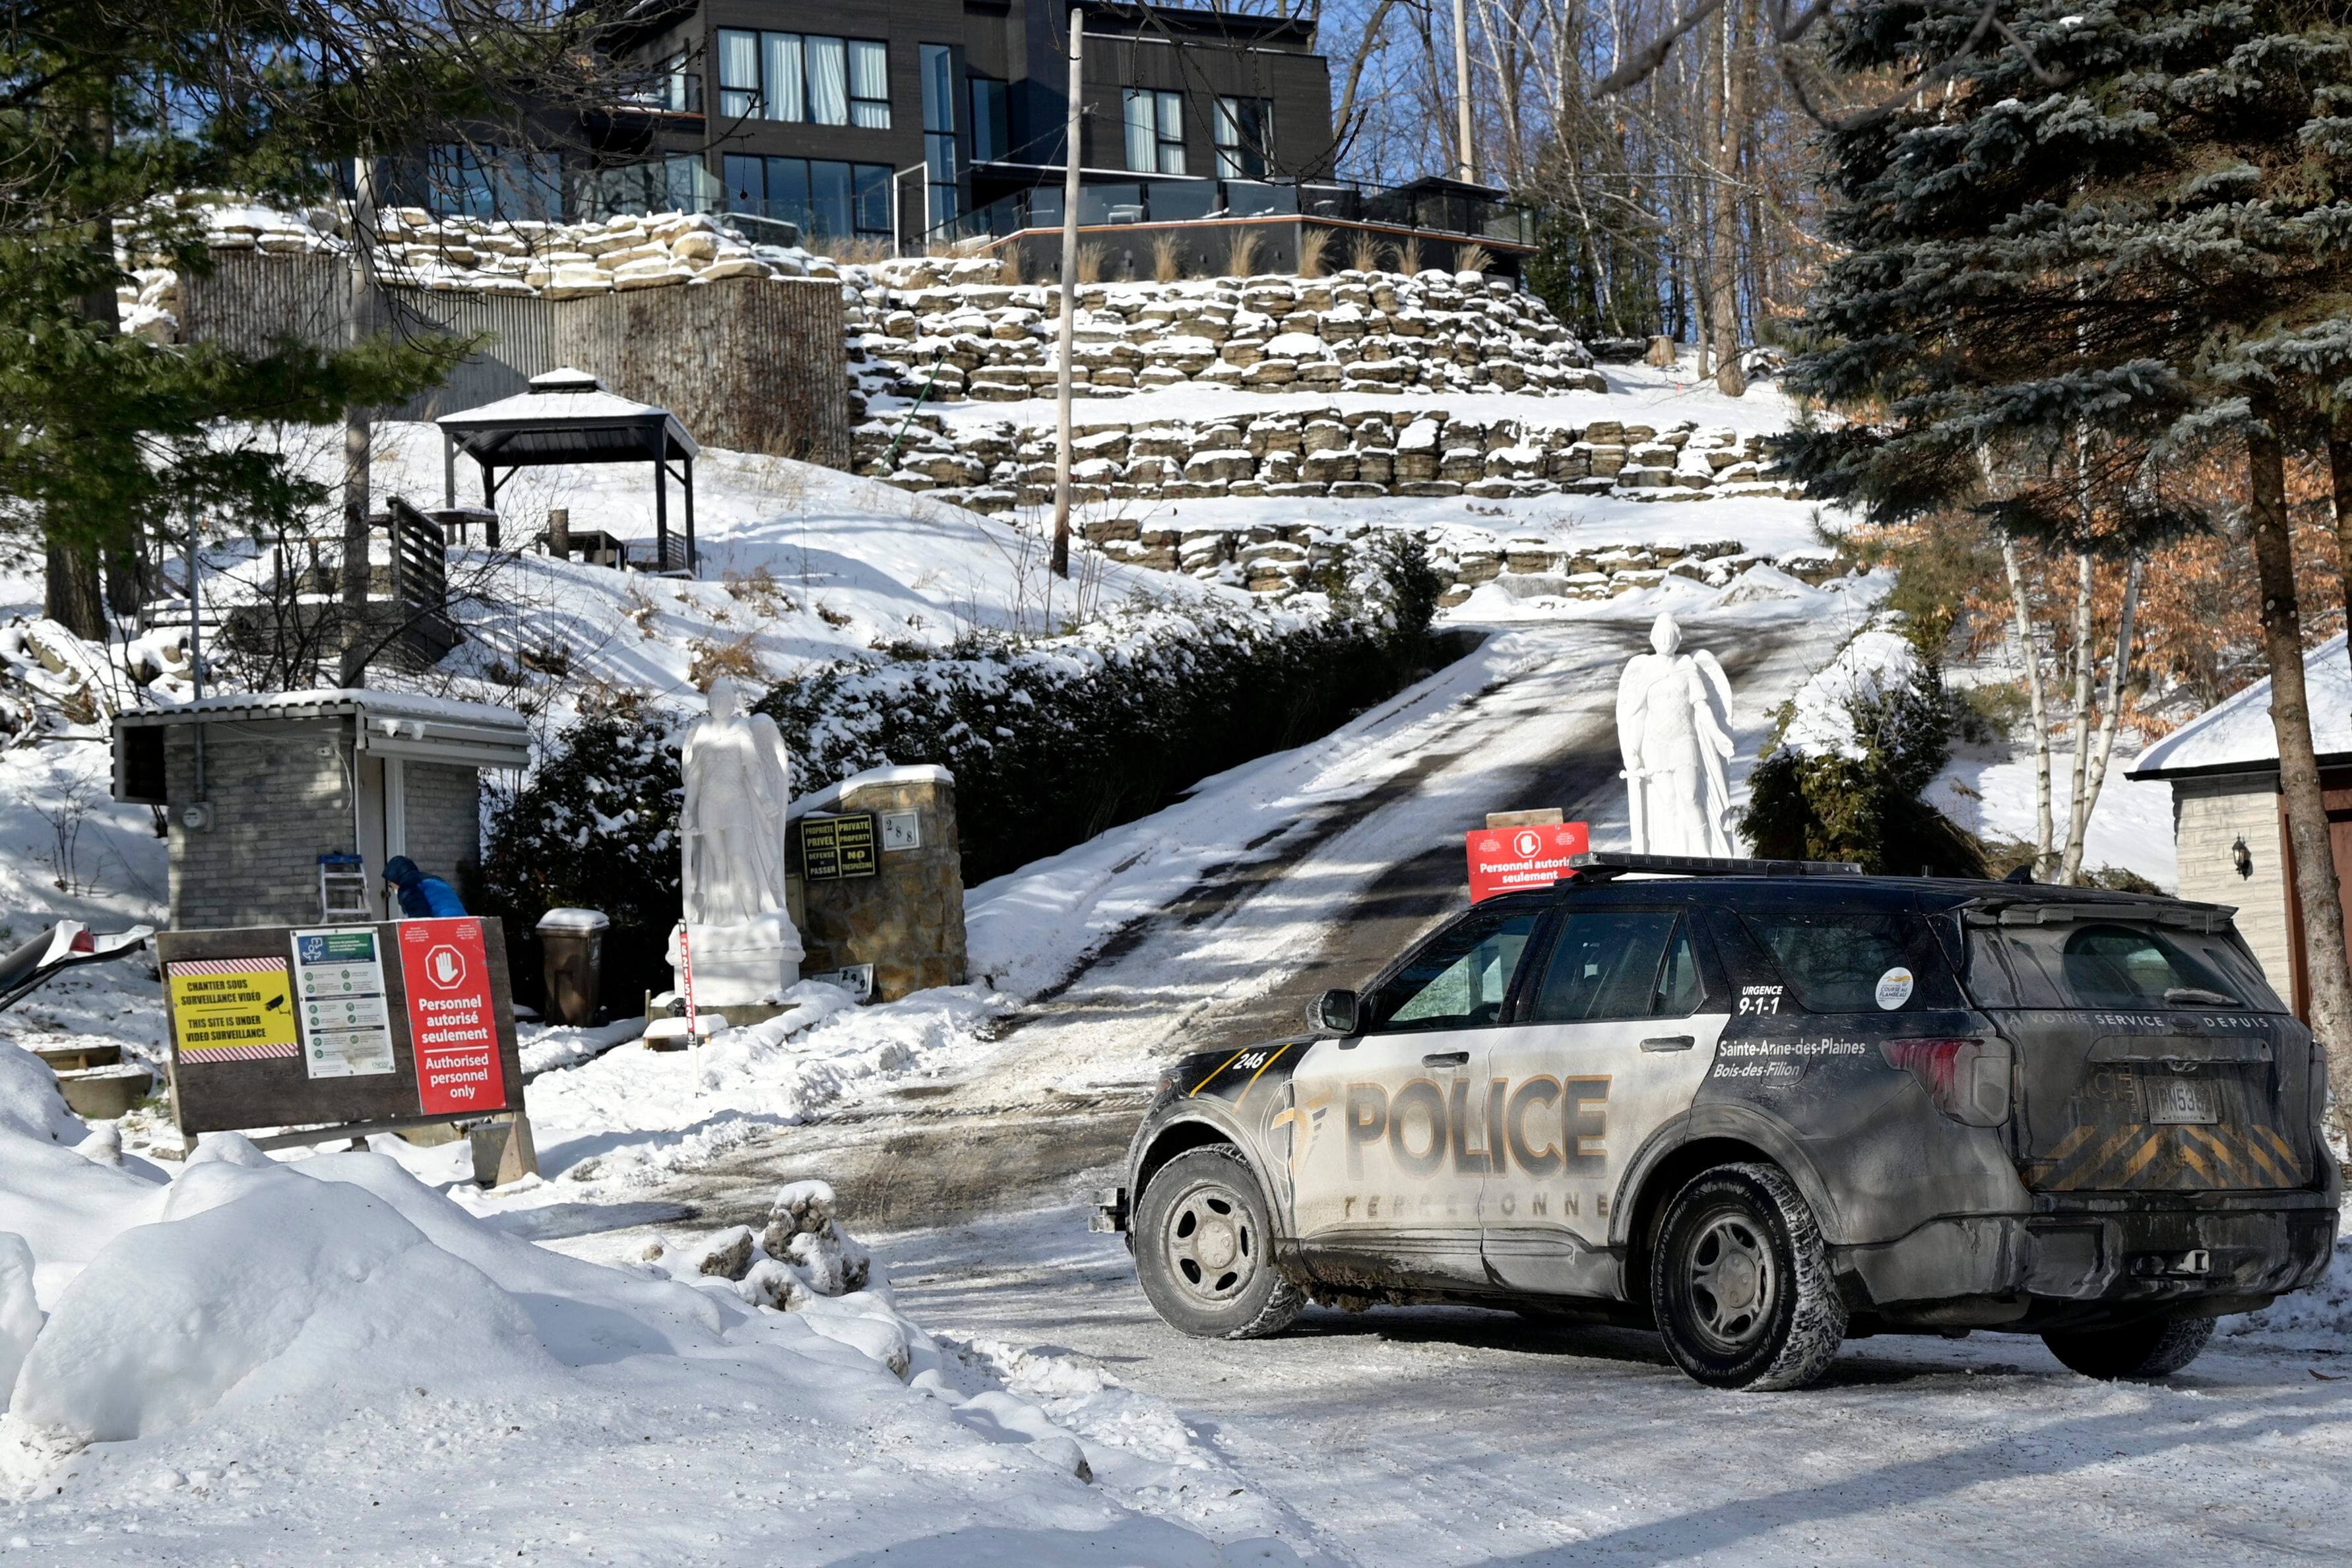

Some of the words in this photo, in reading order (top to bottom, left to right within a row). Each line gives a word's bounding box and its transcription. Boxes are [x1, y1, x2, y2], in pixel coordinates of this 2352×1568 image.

[839, 822, 870, 832] PRIVATE
[886, 819, 912, 843] 288
[839, 833, 870, 842] PROPERTY
[847, 850, 865, 860] NO
[810, 865, 836, 875] PASSER
[842, 862, 872, 871] TRESPASSING
[1480, 860, 1533, 873] Personnel
[1535, 856, 1570, 868] autoris
[1502, 870, 1558, 884] seulement
[187, 980, 225, 991] CHANTIER
[226, 980, 247, 989] SOUS
[1742, 986, 1783, 996] URGENCE
[181, 993, 237, 1005] SURVEILLANCE
[418, 994, 482, 1011] Personnel
[1739, 996, 1780, 1015] 9-1-1
[187, 1019, 207, 1028] THIS
[208, 1017, 225, 1028] SITE
[226, 1017, 234, 1026] IS
[236, 1015, 261, 1026] UNDER
[427, 1011, 479, 1027] autorisé
[2028, 1013, 2090, 1024] VOTRE
[2095, 1014, 2165, 1026] SERVICE
[2204, 1017, 2269, 1028] DEPUIS
[185, 1032, 209, 1042] VIDEO
[211, 1028, 266, 1041] SURVEILLANCE
[422, 1028, 488, 1044] seulement
[1720, 1038, 1866, 1057] Sainte-Anne-des-Plaines
[426, 1053, 489, 1070] Authorised
[1232, 1052, 1267, 1070] 246
[430, 1068, 488, 1088] personnel
[1713, 1062, 1800, 1078] Bois-des-Filion
[450, 1084, 476, 1100] only
[1346, 1074, 1612, 1181] POLICE
